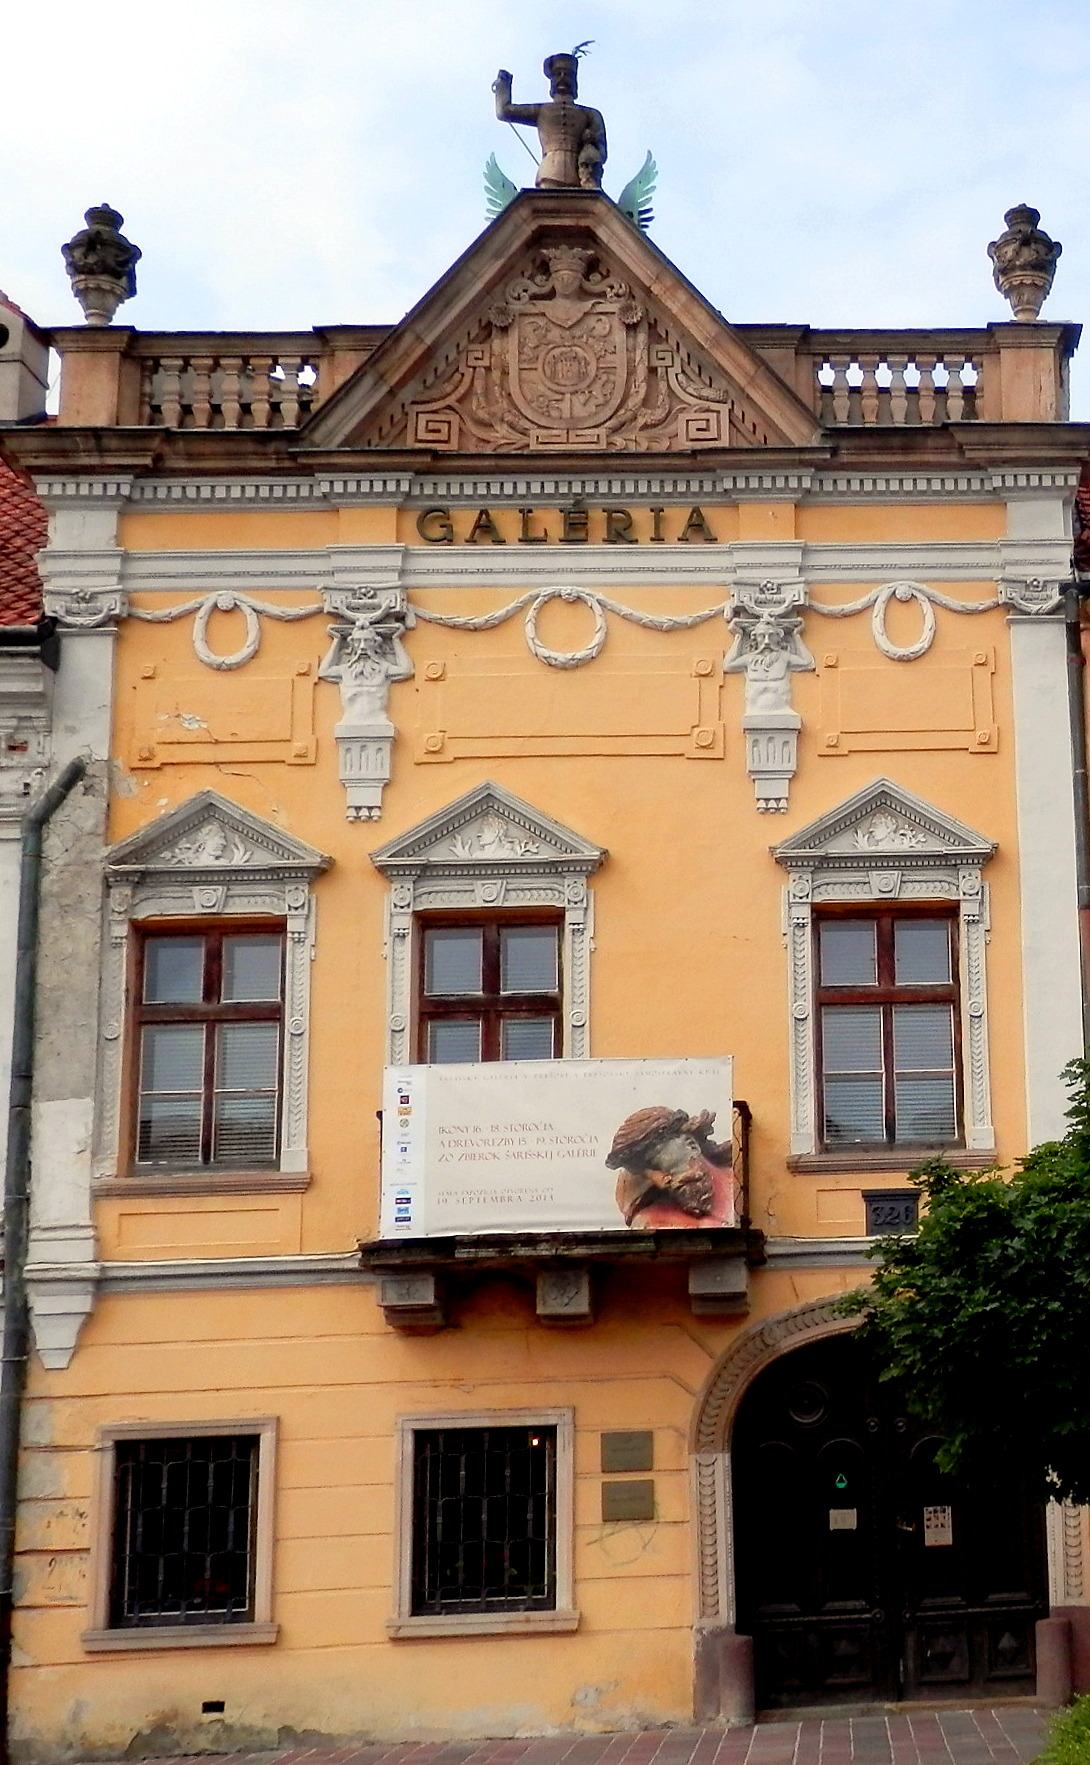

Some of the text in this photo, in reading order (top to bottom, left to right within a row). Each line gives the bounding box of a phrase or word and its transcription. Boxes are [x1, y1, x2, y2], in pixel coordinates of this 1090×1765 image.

[416, 497, 718, 543] GALÉRIA
[438, 1126, 469, 1135] IKONY
[504, 1121, 554, 1132] STOROČIA
[549, 1133, 599, 1145] STOROČIA
[438, 1153, 454, 1163] ZO
[457, 1152, 501, 1162] ZBIEROK
